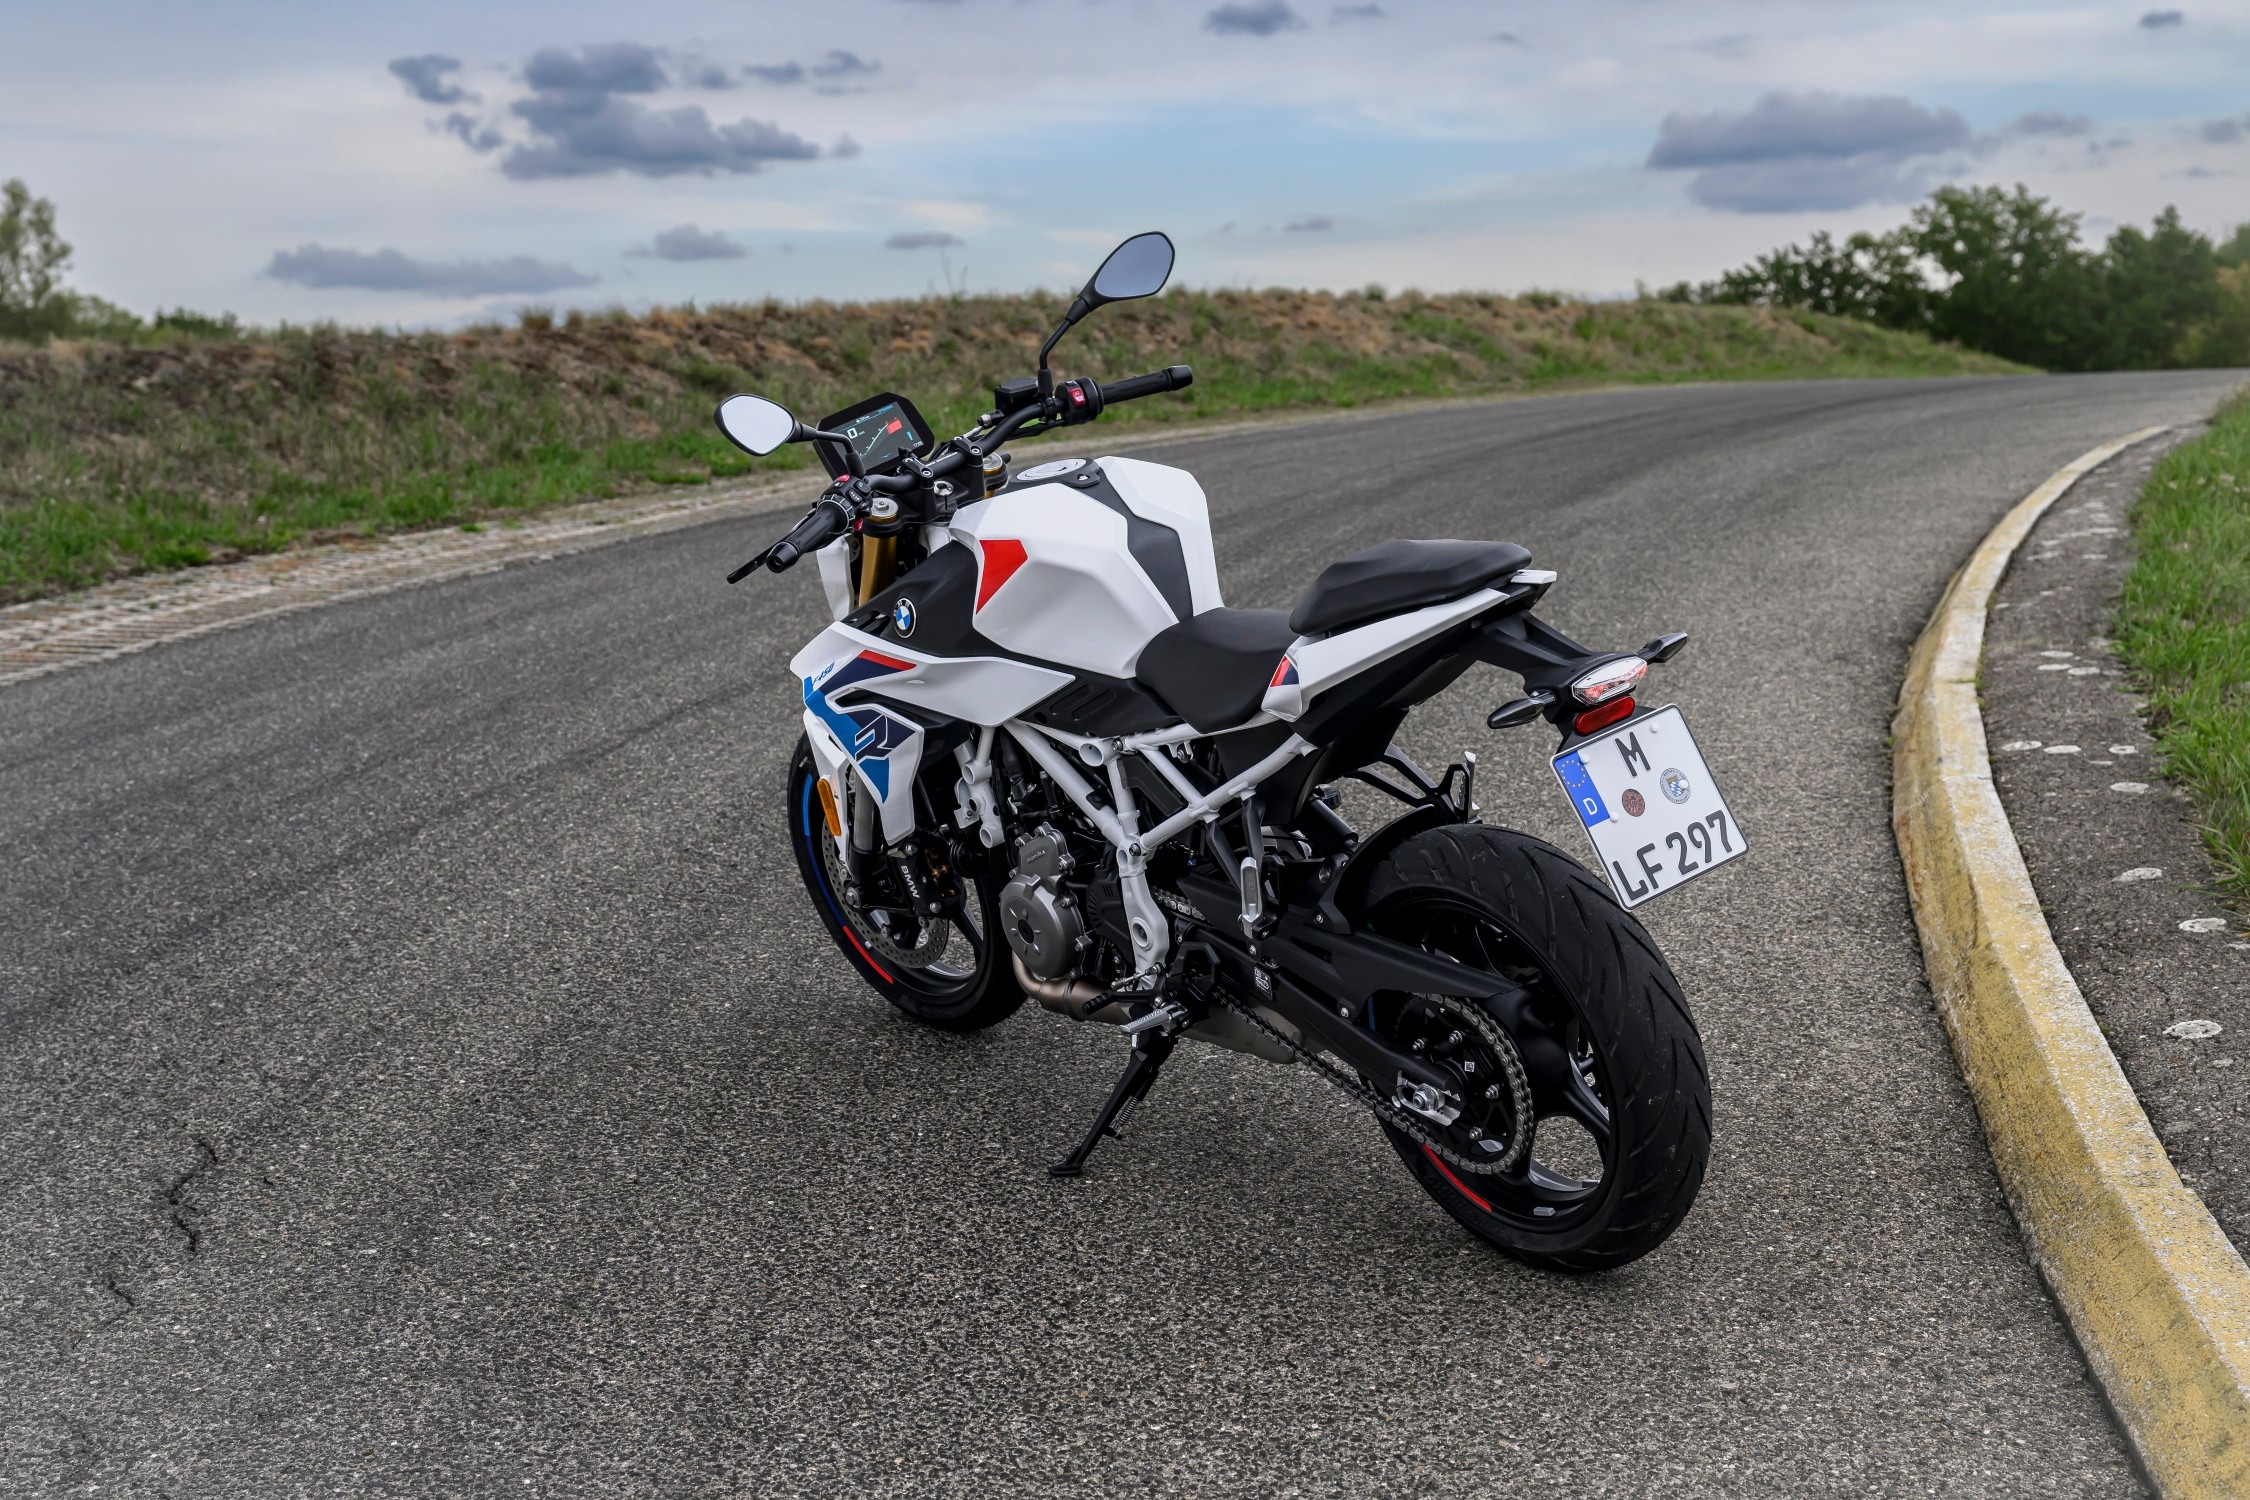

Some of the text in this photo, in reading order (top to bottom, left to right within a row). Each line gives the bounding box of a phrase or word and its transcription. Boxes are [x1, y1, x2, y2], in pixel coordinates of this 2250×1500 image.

[847, 427, 858, 440] 0
[1615, 732, 1651, 777] M
[1583, 797, 1598, 816] D
[1612, 809, 1733, 901] LF 297
[901, 865, 920, 899] BMW
